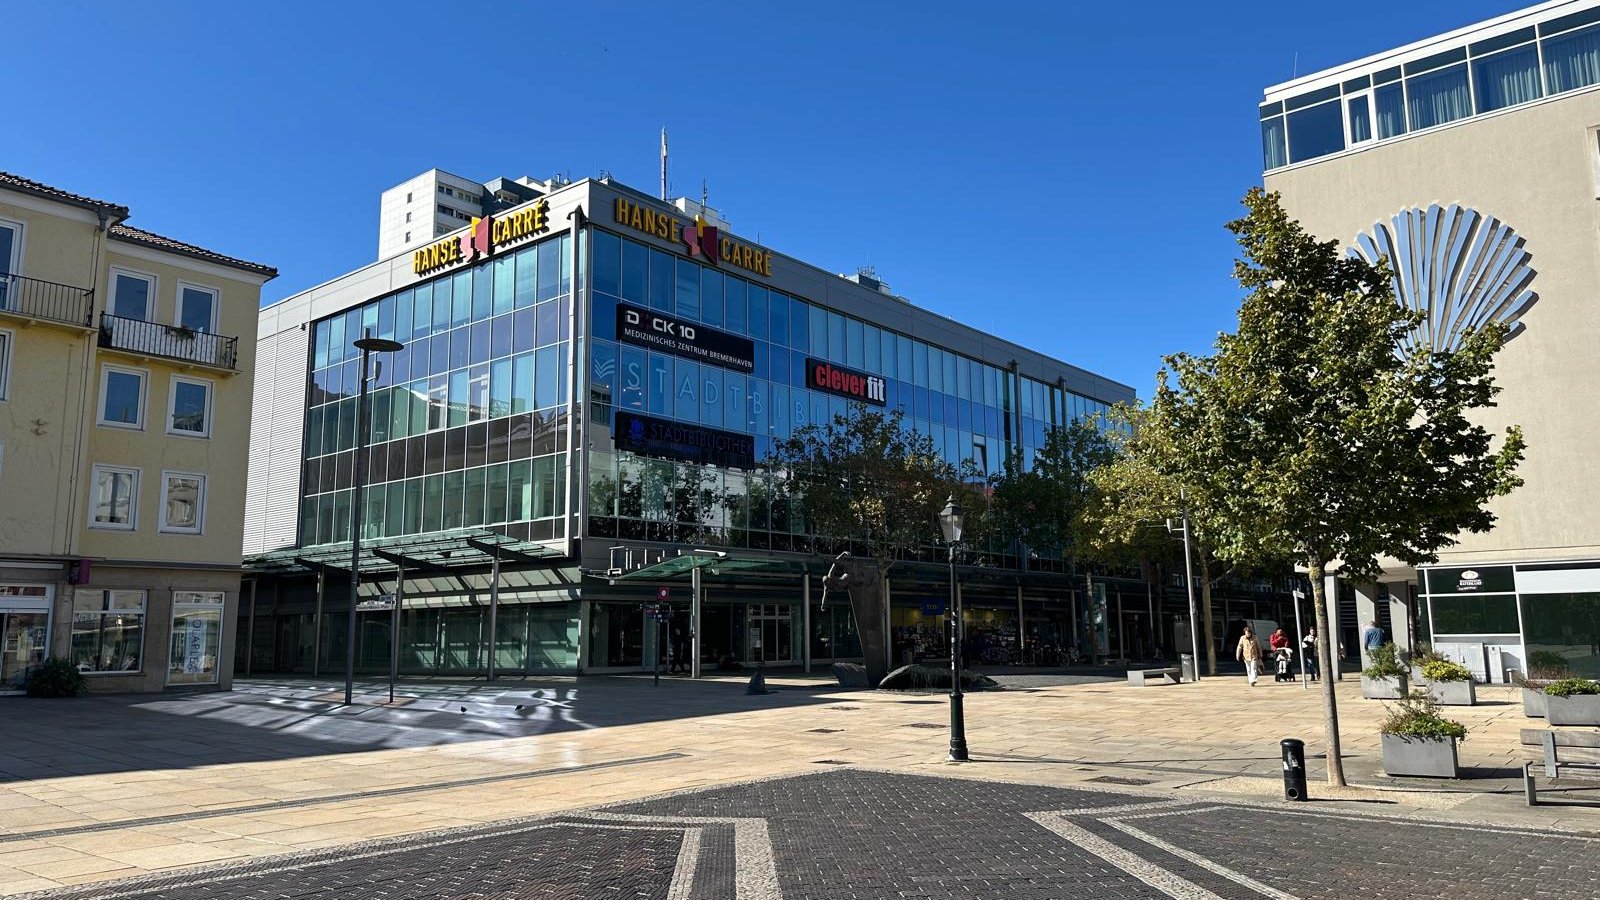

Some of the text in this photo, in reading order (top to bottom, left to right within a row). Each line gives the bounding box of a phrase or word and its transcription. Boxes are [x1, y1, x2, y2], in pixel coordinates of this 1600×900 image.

[413, 199, 545, 274] HANSE CARRÉ
[616, 197, 773, 277] HANSE CARRÉ
[624, 327, 753, 368] MEDIZINISCHES ZENTRUM BREMERHAVEN
[679, 325, 695, 340] 10
